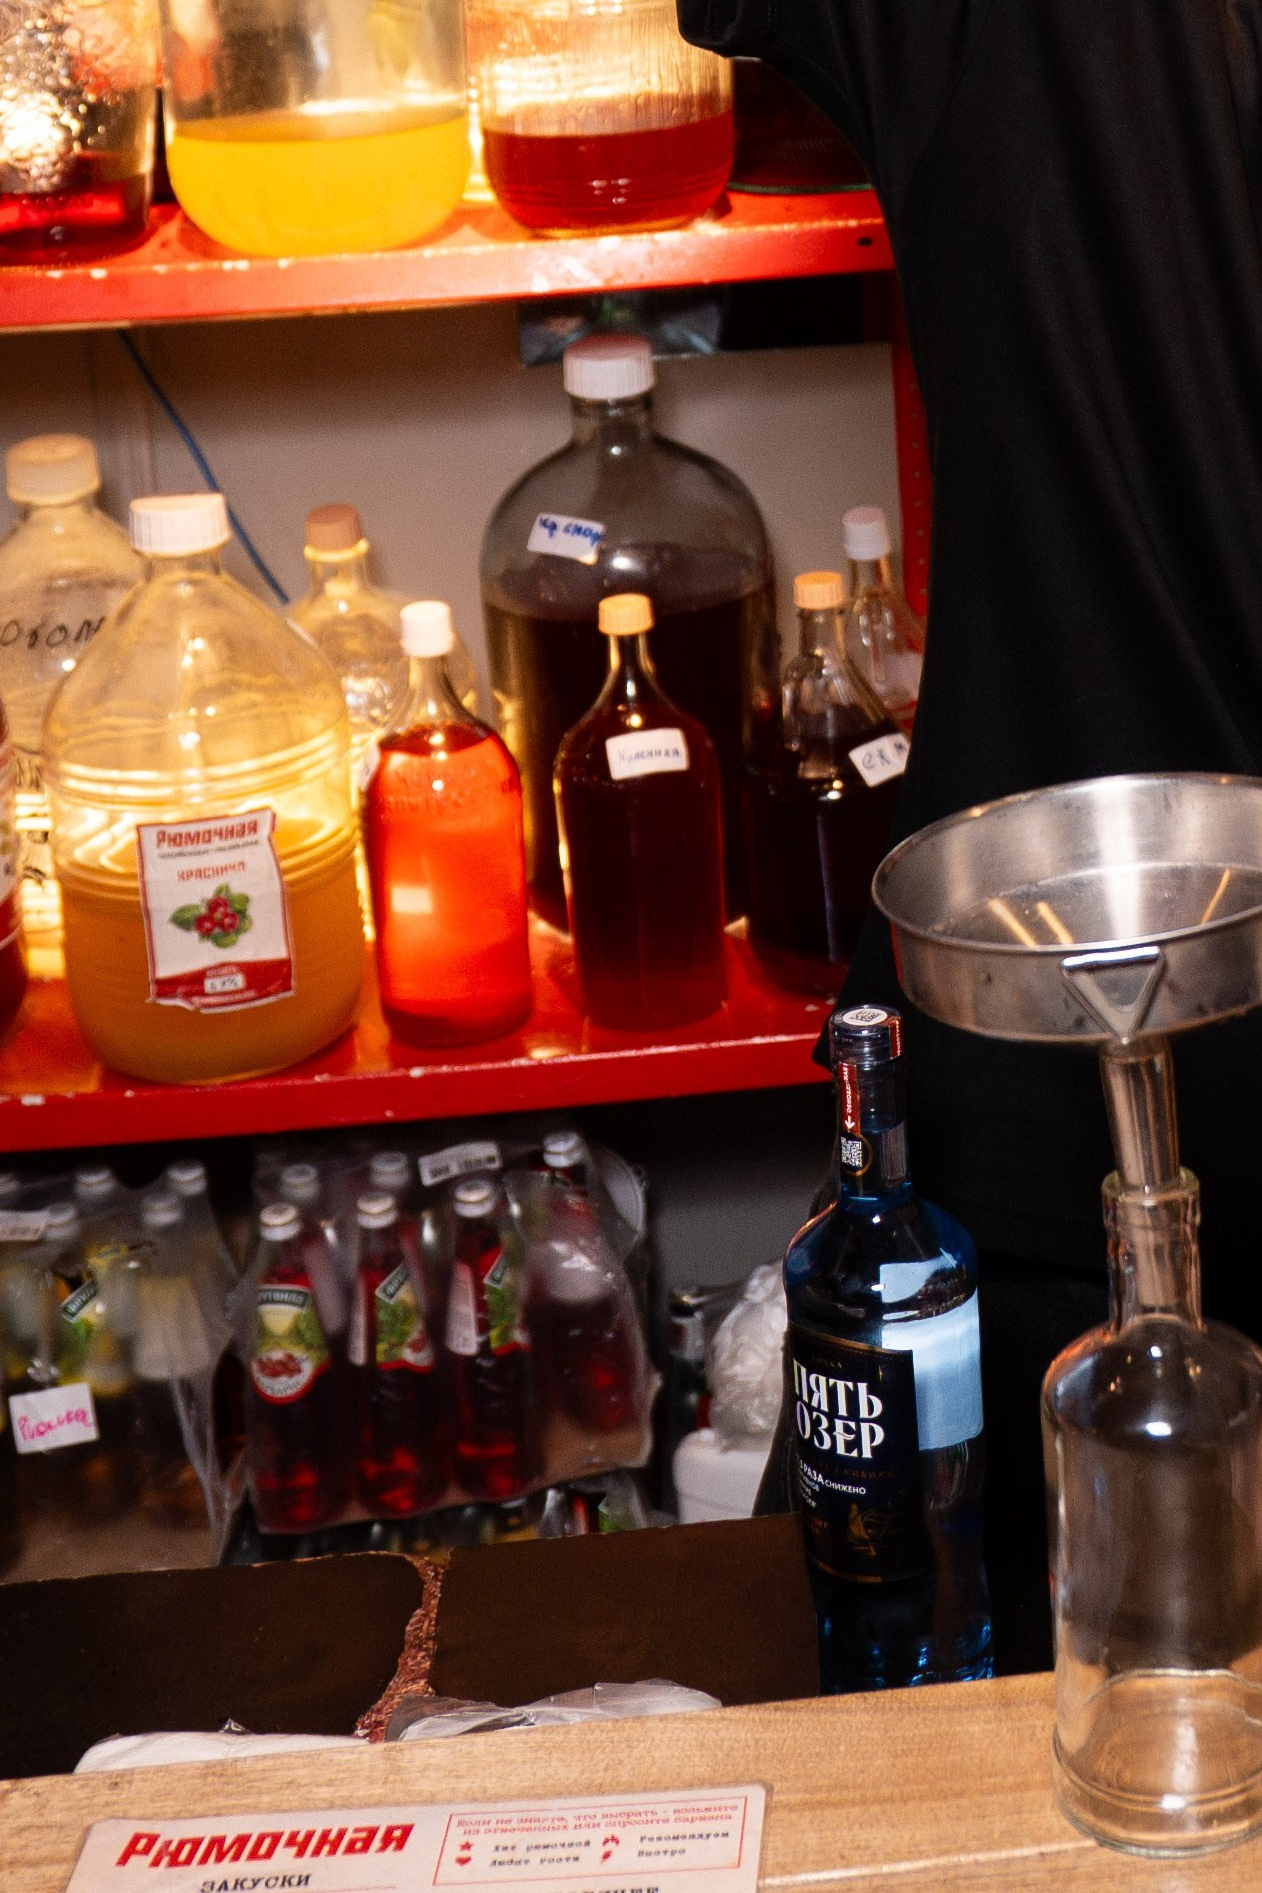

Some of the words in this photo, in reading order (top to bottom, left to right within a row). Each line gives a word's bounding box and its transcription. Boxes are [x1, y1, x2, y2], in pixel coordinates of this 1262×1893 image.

[793, 1358, 883, 1419] ПЯТЬ
[796, 1401, 885, 1459] ОЗЕР
[825, 1479, 866, 1495] СНИЖЕНО
[114, 1824, 415, 1868] Рюмочная
[200, 1873, 312, 1893] ЗАКУСКИ
